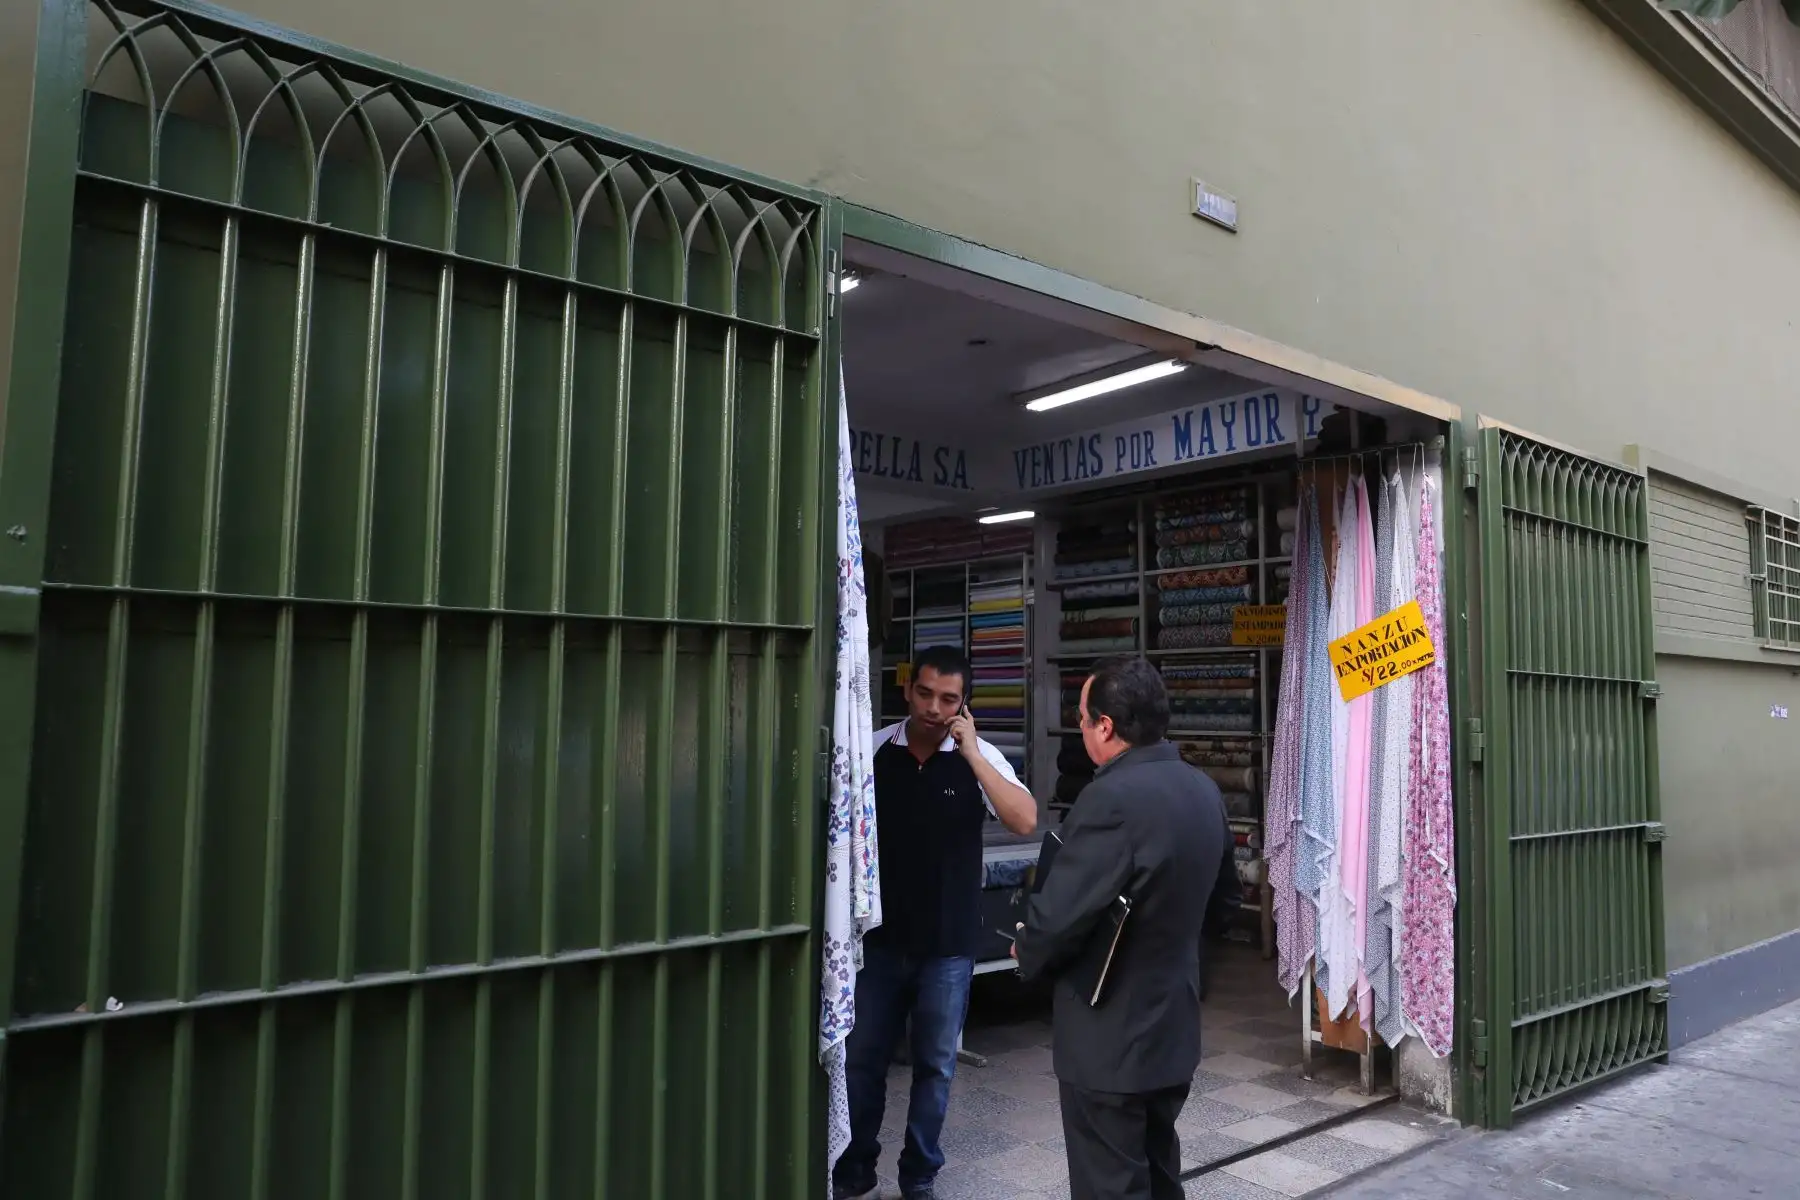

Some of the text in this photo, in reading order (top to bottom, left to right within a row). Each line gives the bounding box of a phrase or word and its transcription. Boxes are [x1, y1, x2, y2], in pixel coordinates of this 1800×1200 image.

[1012, 393, 1320, 489] VENTAS POR MAYOR Y
[1336, 624, 1427, 678] EXPORTACION
[1340, 616, 1408, 659] NANZU
